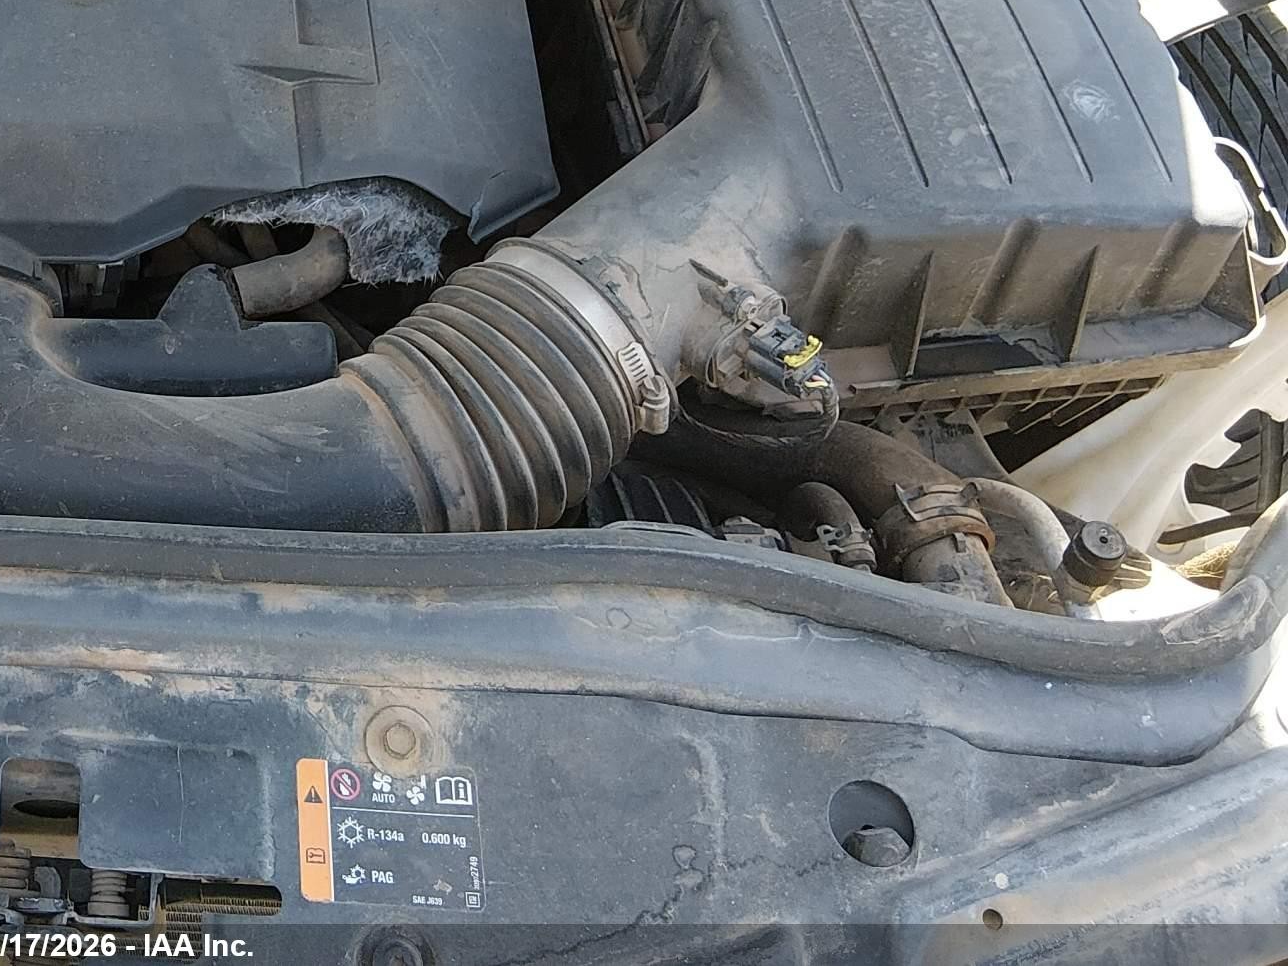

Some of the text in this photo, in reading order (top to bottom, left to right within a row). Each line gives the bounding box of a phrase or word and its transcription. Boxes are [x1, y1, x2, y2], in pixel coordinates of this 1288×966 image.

[372, 792, 395, 804] AUTO
[367, 828, 405, 842] R-134a
[421, 832, 466, 848] 0.600 kg
[371, 870, 394, 884] PAG
[412, 895, 426, 904] SAE
